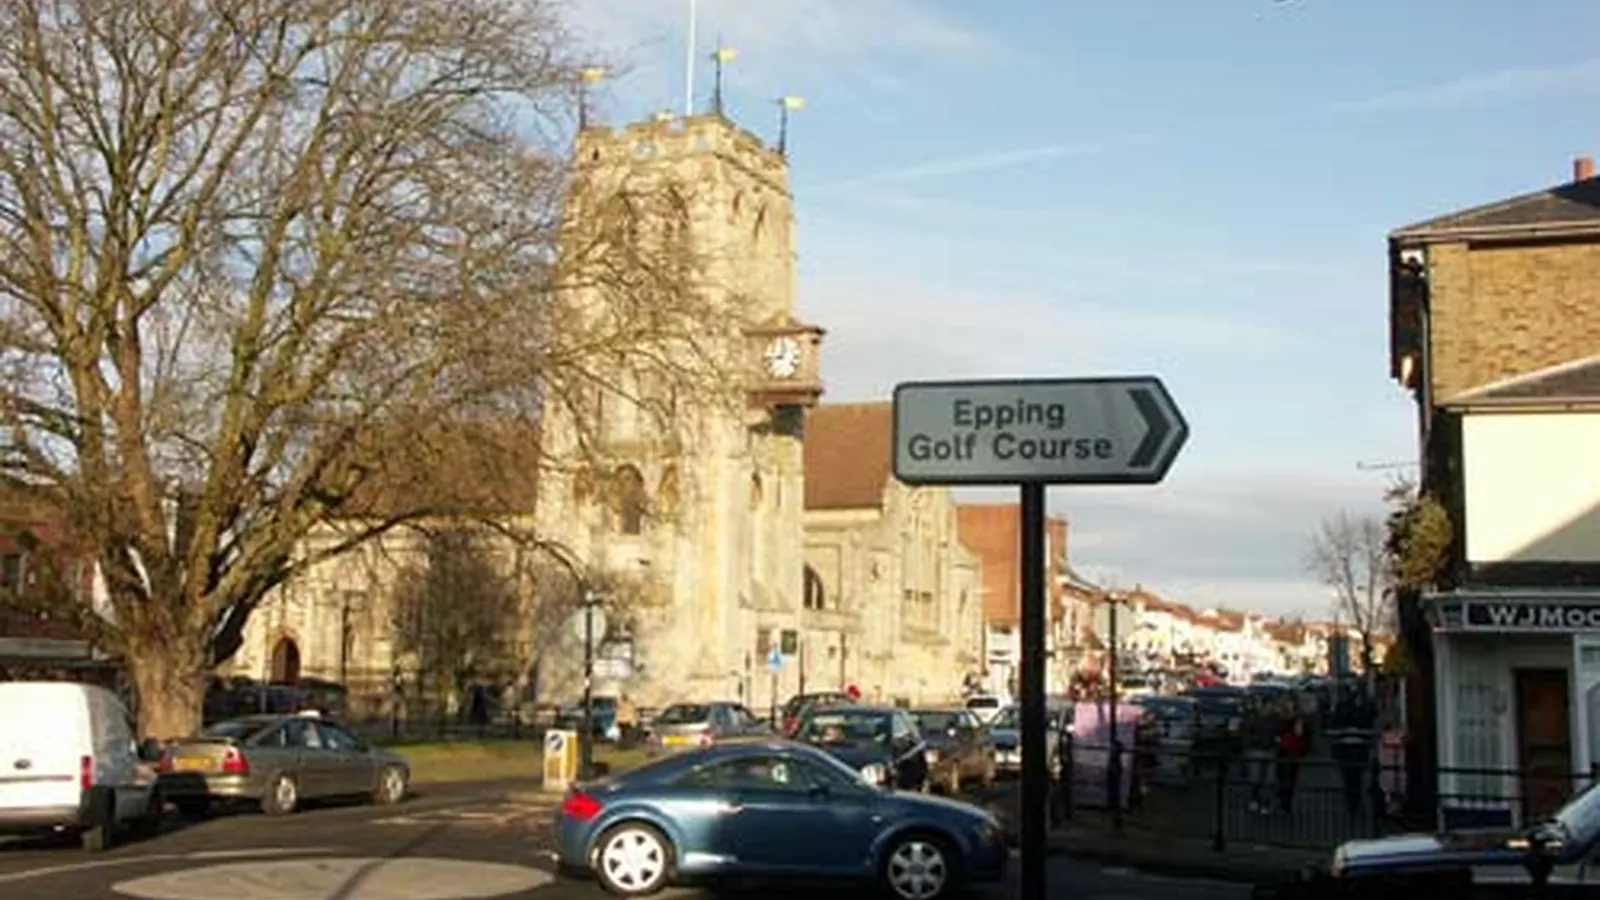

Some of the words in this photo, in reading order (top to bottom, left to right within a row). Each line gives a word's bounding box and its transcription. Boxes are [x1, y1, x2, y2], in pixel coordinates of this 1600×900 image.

[953, 399, 1065, 429] Epping
[908, 433, 977, 461] Golf
[993, 433, 1112, 459] Course
